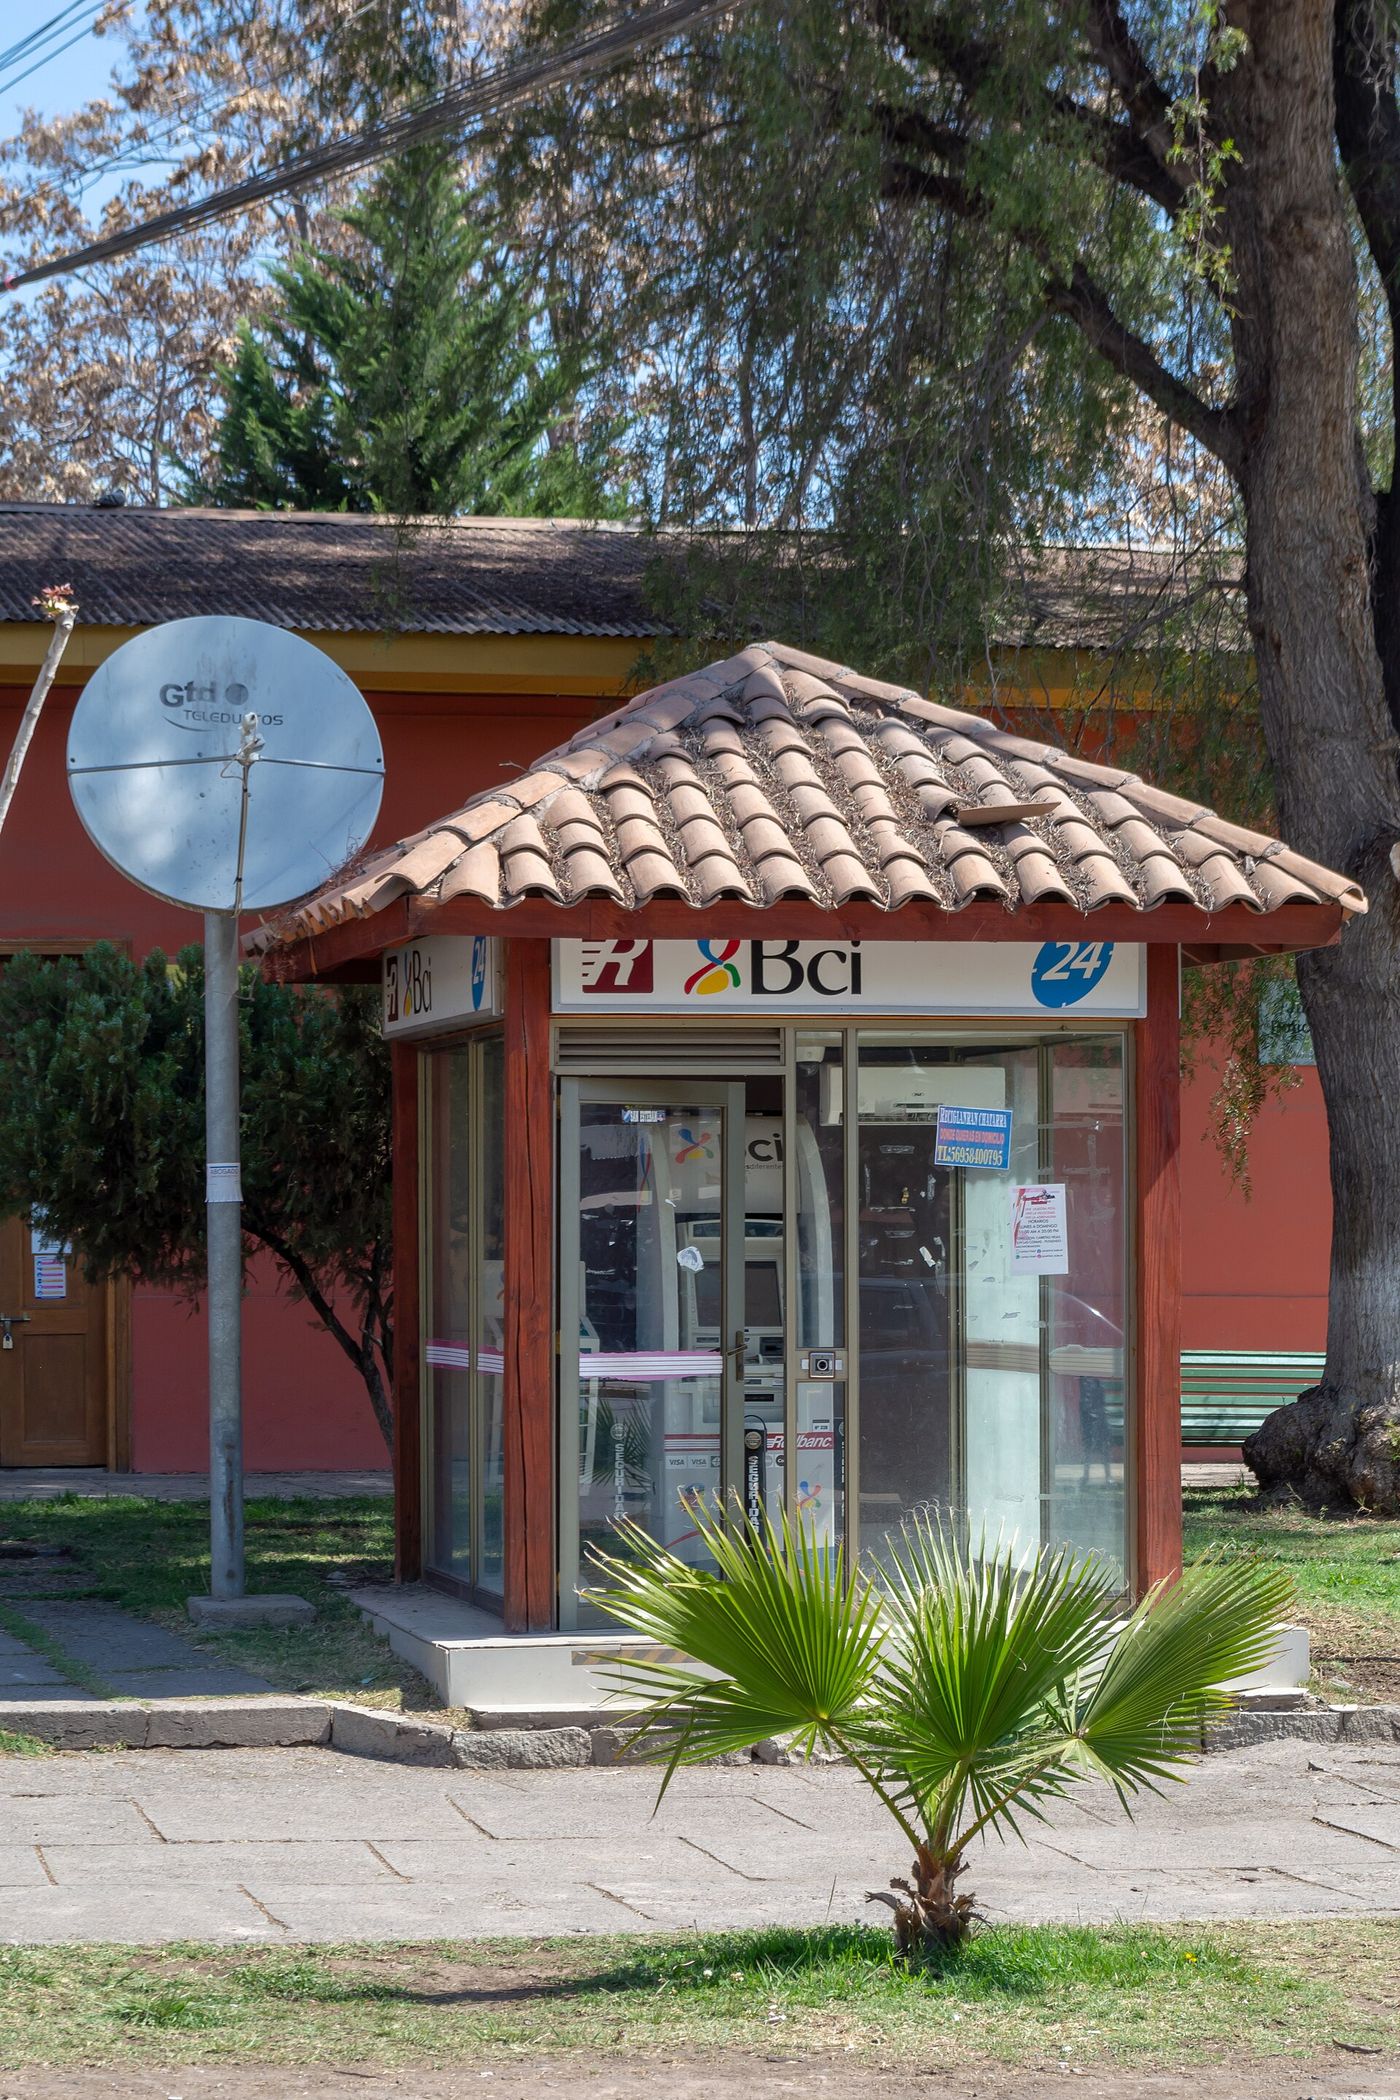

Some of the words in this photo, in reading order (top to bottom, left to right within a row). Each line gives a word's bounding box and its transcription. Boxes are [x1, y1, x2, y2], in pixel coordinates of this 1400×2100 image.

[159, 681, 216, 708] Gtd
[183, 709, 284, 726] TELEDUOS
[412, 950, 432, 1014] Bci
[751, 940, 861, 996] Bci
[1041, 942, 1104, 981] 24
[745, 1133, 784, 1162] ci
[691, 1458, 707, 1466] VISA
